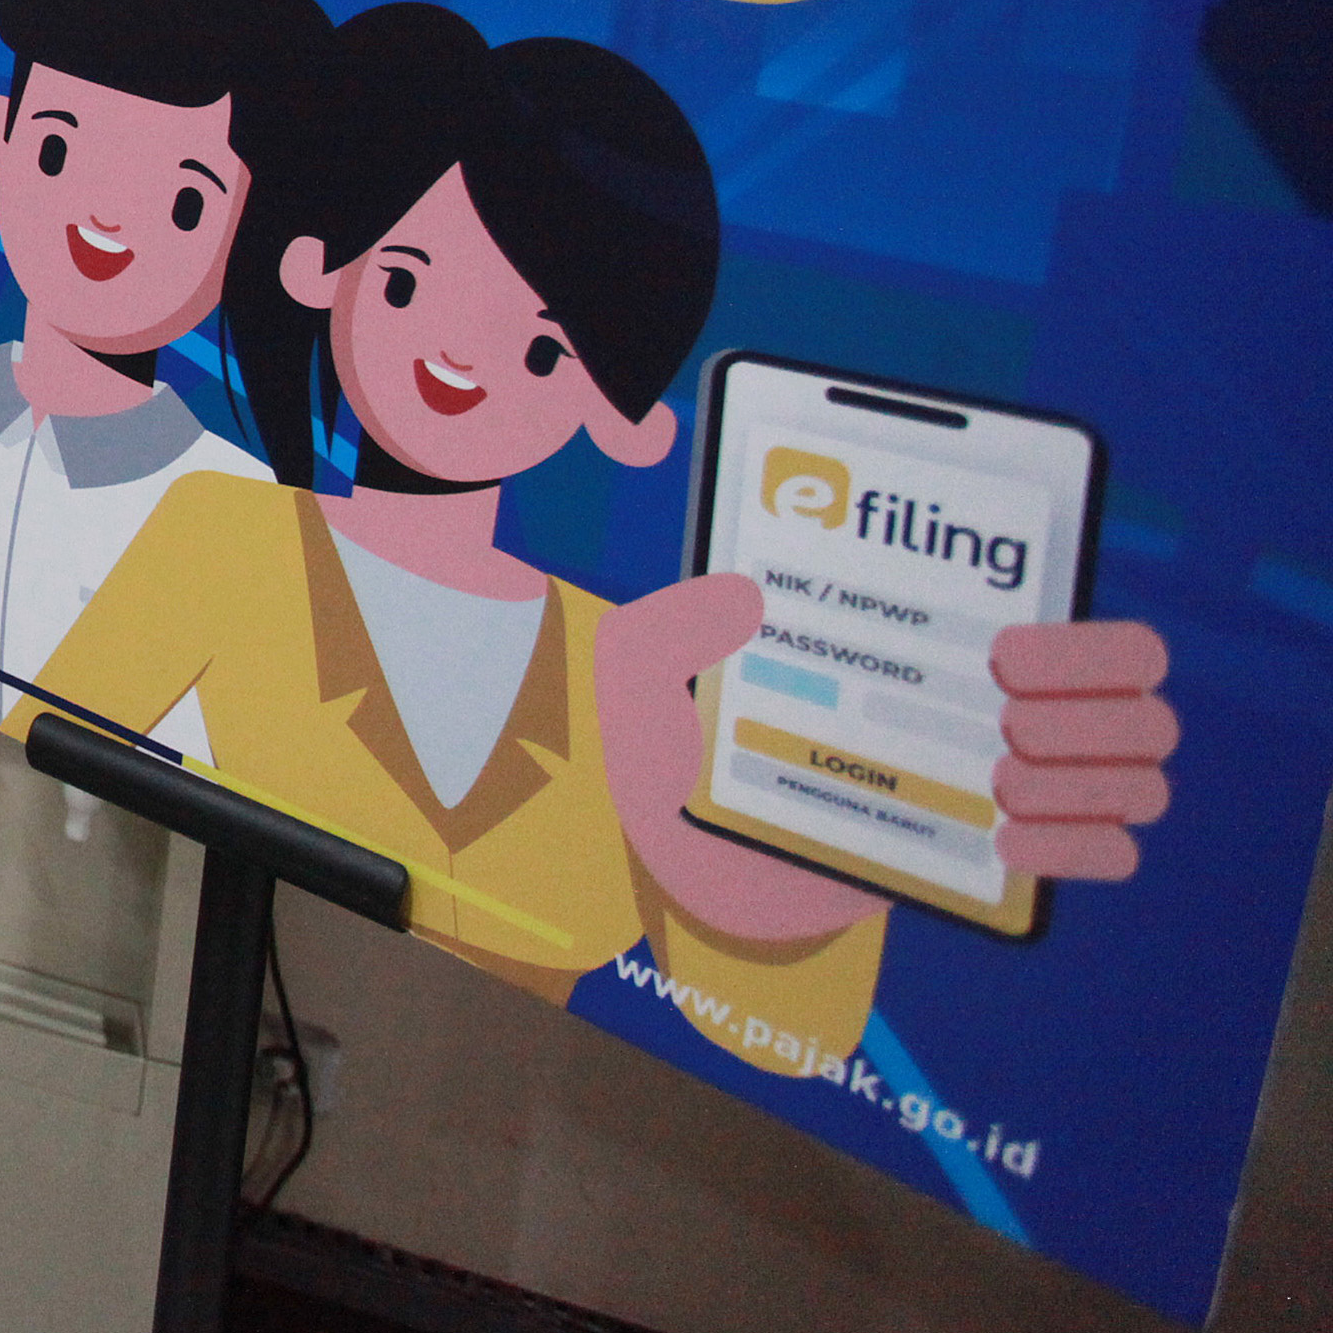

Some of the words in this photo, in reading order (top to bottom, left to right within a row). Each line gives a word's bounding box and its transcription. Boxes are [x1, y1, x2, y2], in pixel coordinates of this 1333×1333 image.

[854, 489, 1028, 592] filing
[765, 569, 813, 597] NIK
[839, 589, 930, 627] NPWP
[760, 623, 926, 685] PASSWORD
[809, 750, 899, 793] LOGIN
[614, 952, 1042, 1179] www.pajak.go.id
